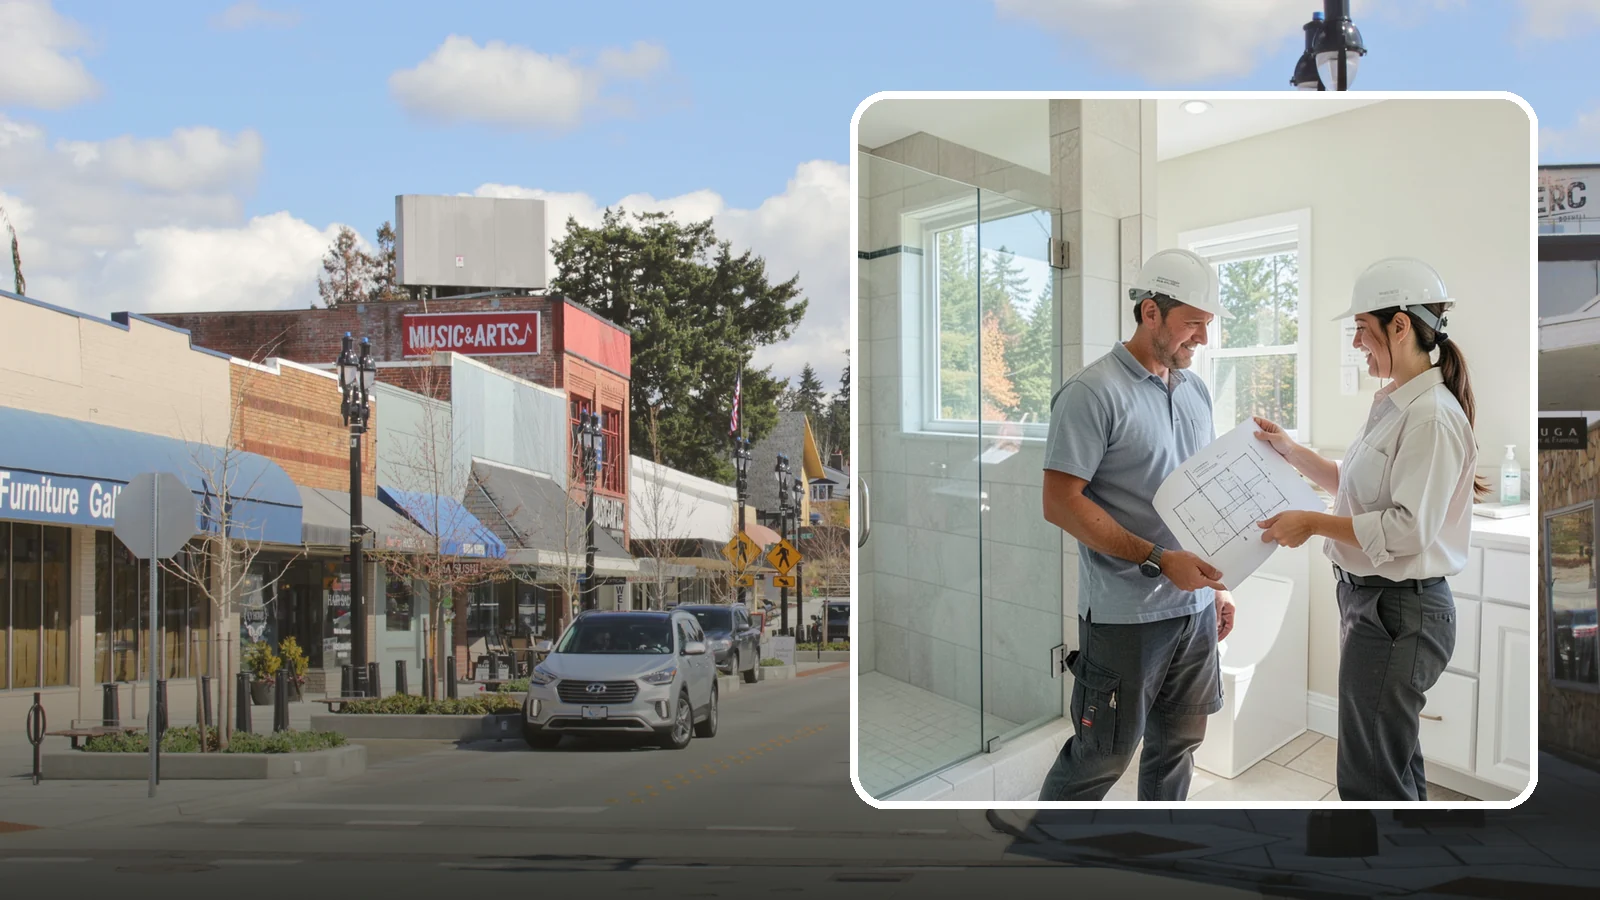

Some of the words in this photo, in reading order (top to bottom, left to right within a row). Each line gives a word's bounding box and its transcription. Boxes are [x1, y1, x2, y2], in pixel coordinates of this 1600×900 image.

[409, 323, 519, 348] MUSIC&ARTS
[0, 471, 79, 515] Furniture
[453, 563, 479, 575] SUSHI
